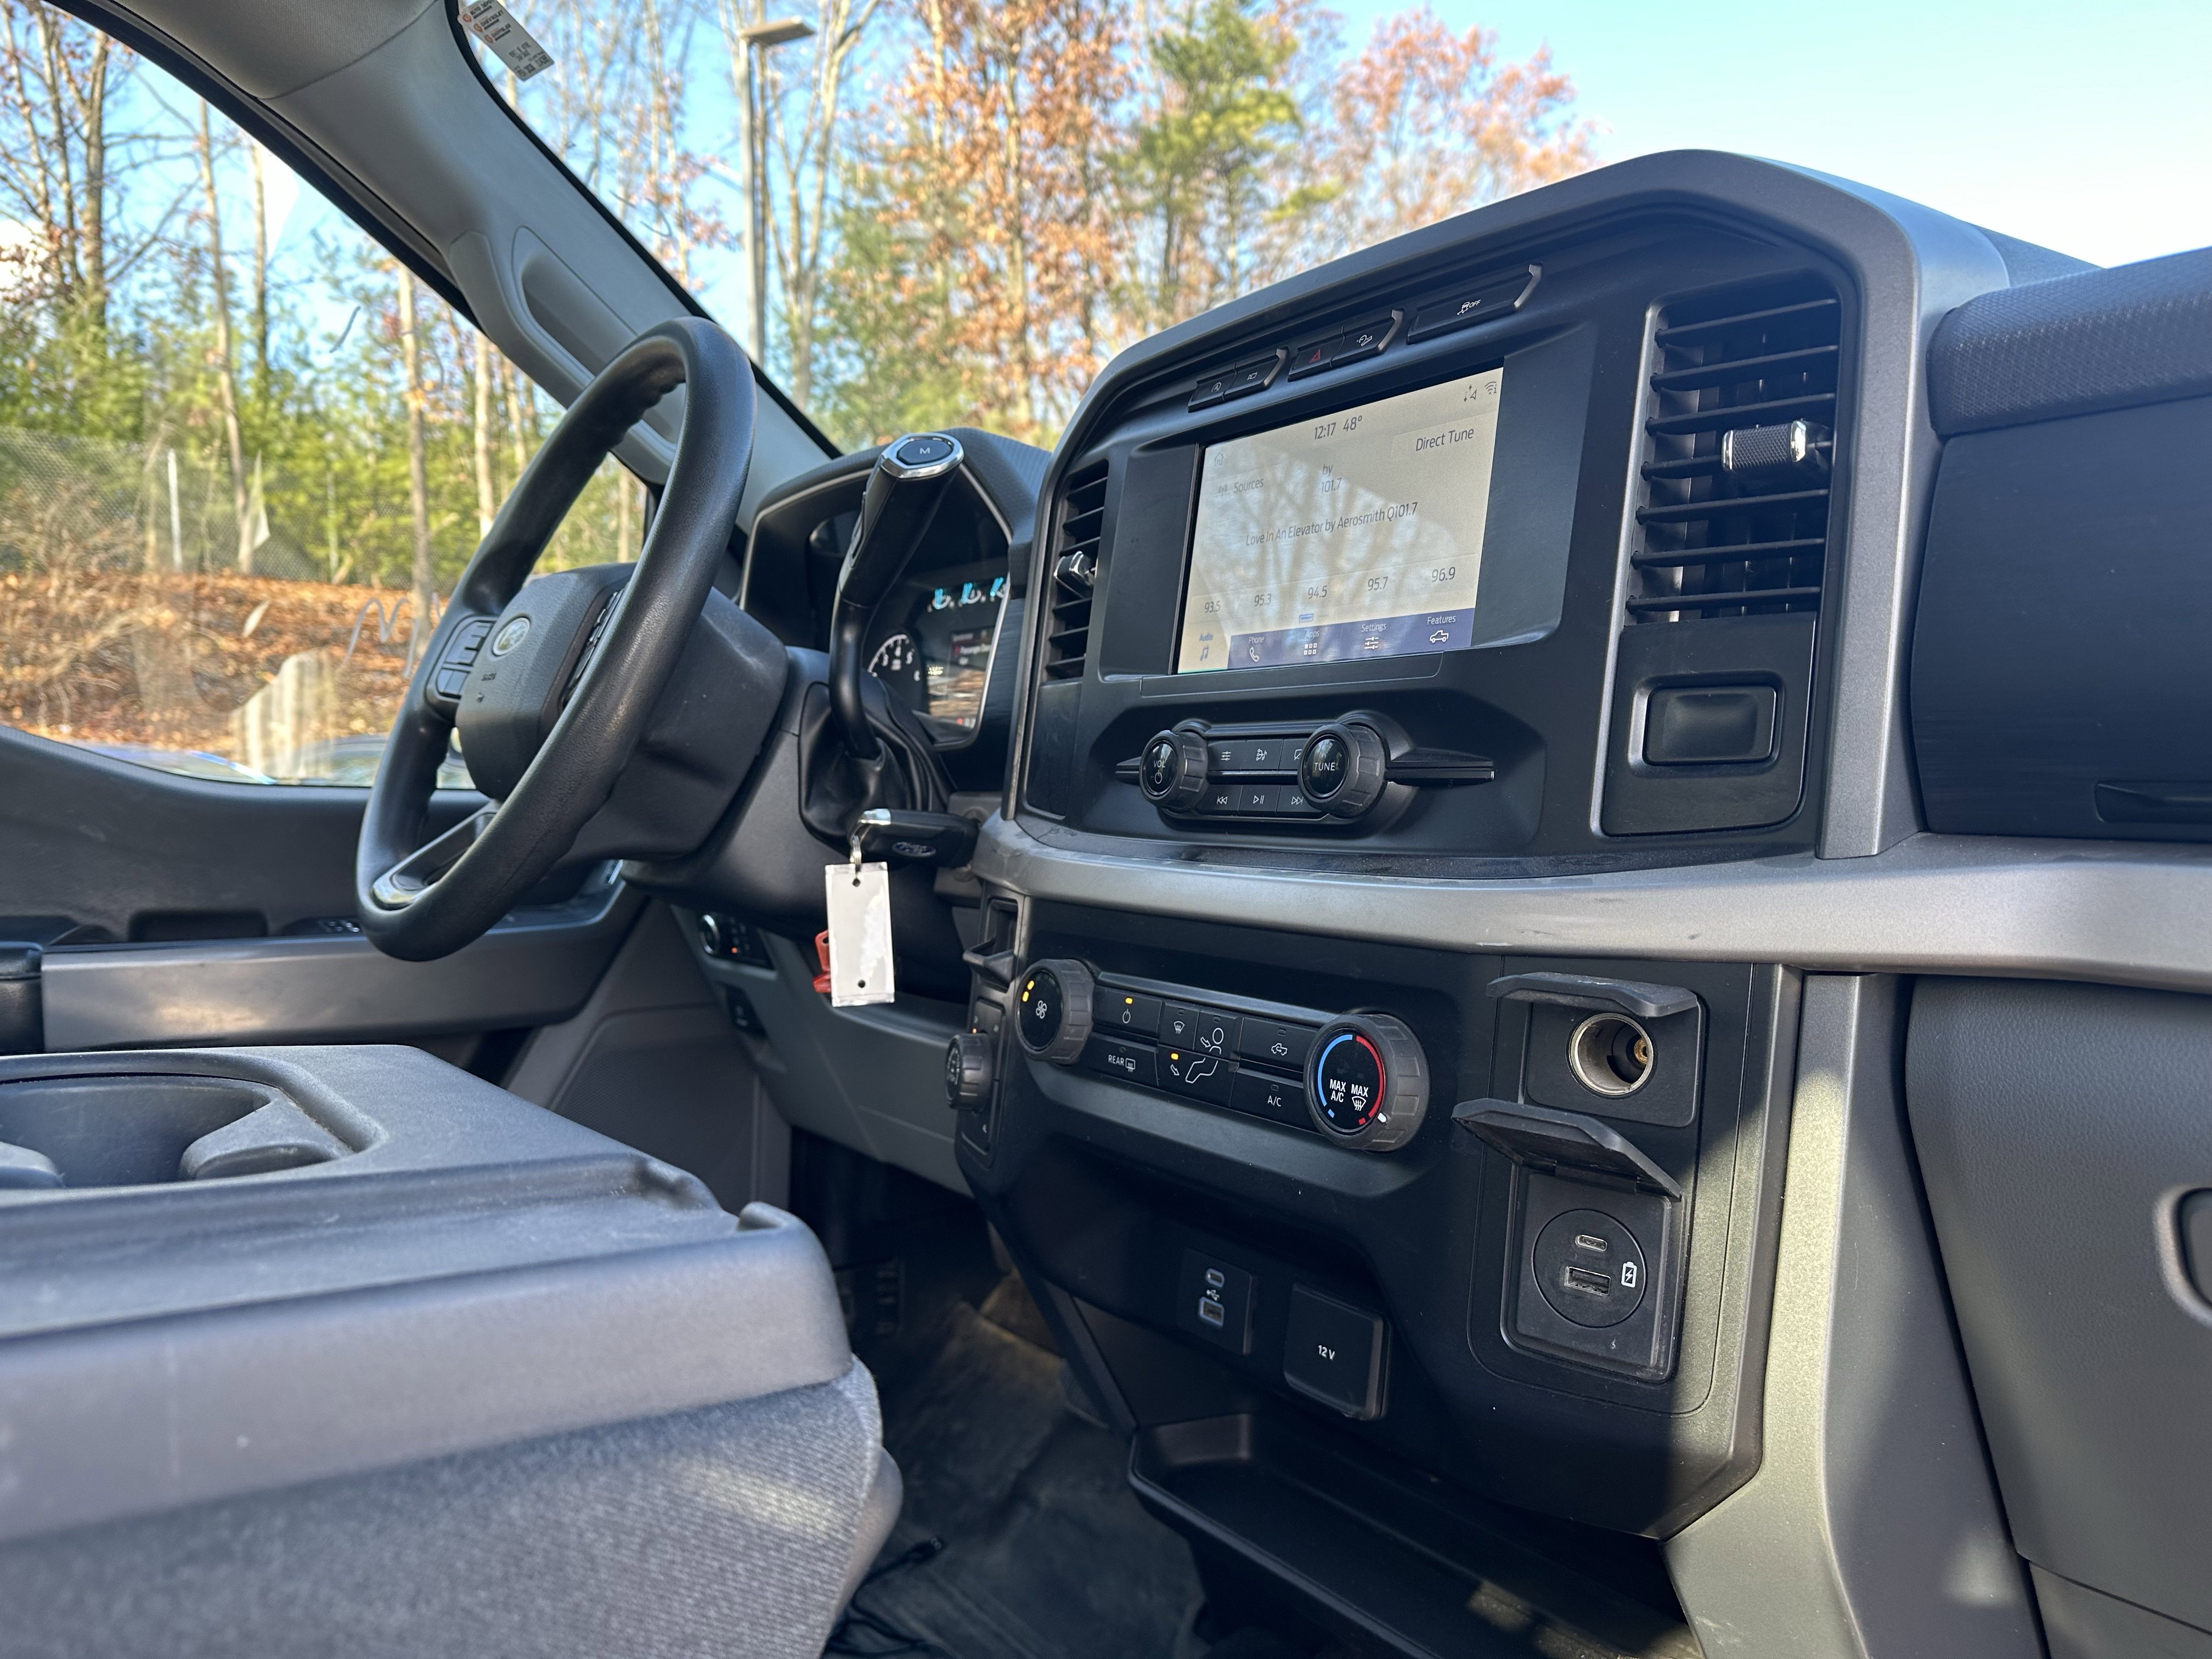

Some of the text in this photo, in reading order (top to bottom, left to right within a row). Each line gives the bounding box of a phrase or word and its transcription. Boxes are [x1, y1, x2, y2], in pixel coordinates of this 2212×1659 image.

[1469, 300, 1481, 308] OFF
[1314, 415, 1363, 439] 12:17 48°
[1415, 428, 1474, 452] Direct Tune
[1322, 463, 1333, 476] by
[1233, 478, 1264, 493] Sources
[1321, 478, 1342, 494] 101.7
[1246, 501, 1418, 546] Love In An Elevator by Aerosmith Q101.7
[1431, 567, 1455, 583] 96.9
[1368, 576, 1389, 591] 95.7
[1308, 585, 1328, 599] 94.5
[1254, 593, 1272, 607] 95.3
[1204, 601, 1220, 613] 93.5
[1427, 614, 1456, 625] Features
[1361, 622, 1386, 633] Settings
[1199, 633, 1214, 642] Audio
[1248, 636, 1265, 644] Phone
[1305, 630, 1319, 639] Apps
[1153, 760, 1166, 768] VOL
[1314, 762, 1335, 771] TUNE
[1108, 1054, 1125, 1066] REAR
[1329, 1079, 1346, 1092] MAX
[1351, 1084, 1369, 1098] MAX
[1267, 1095, 1282, 1107] A/C
[1330, 1090, 1344, 1103] A/C
